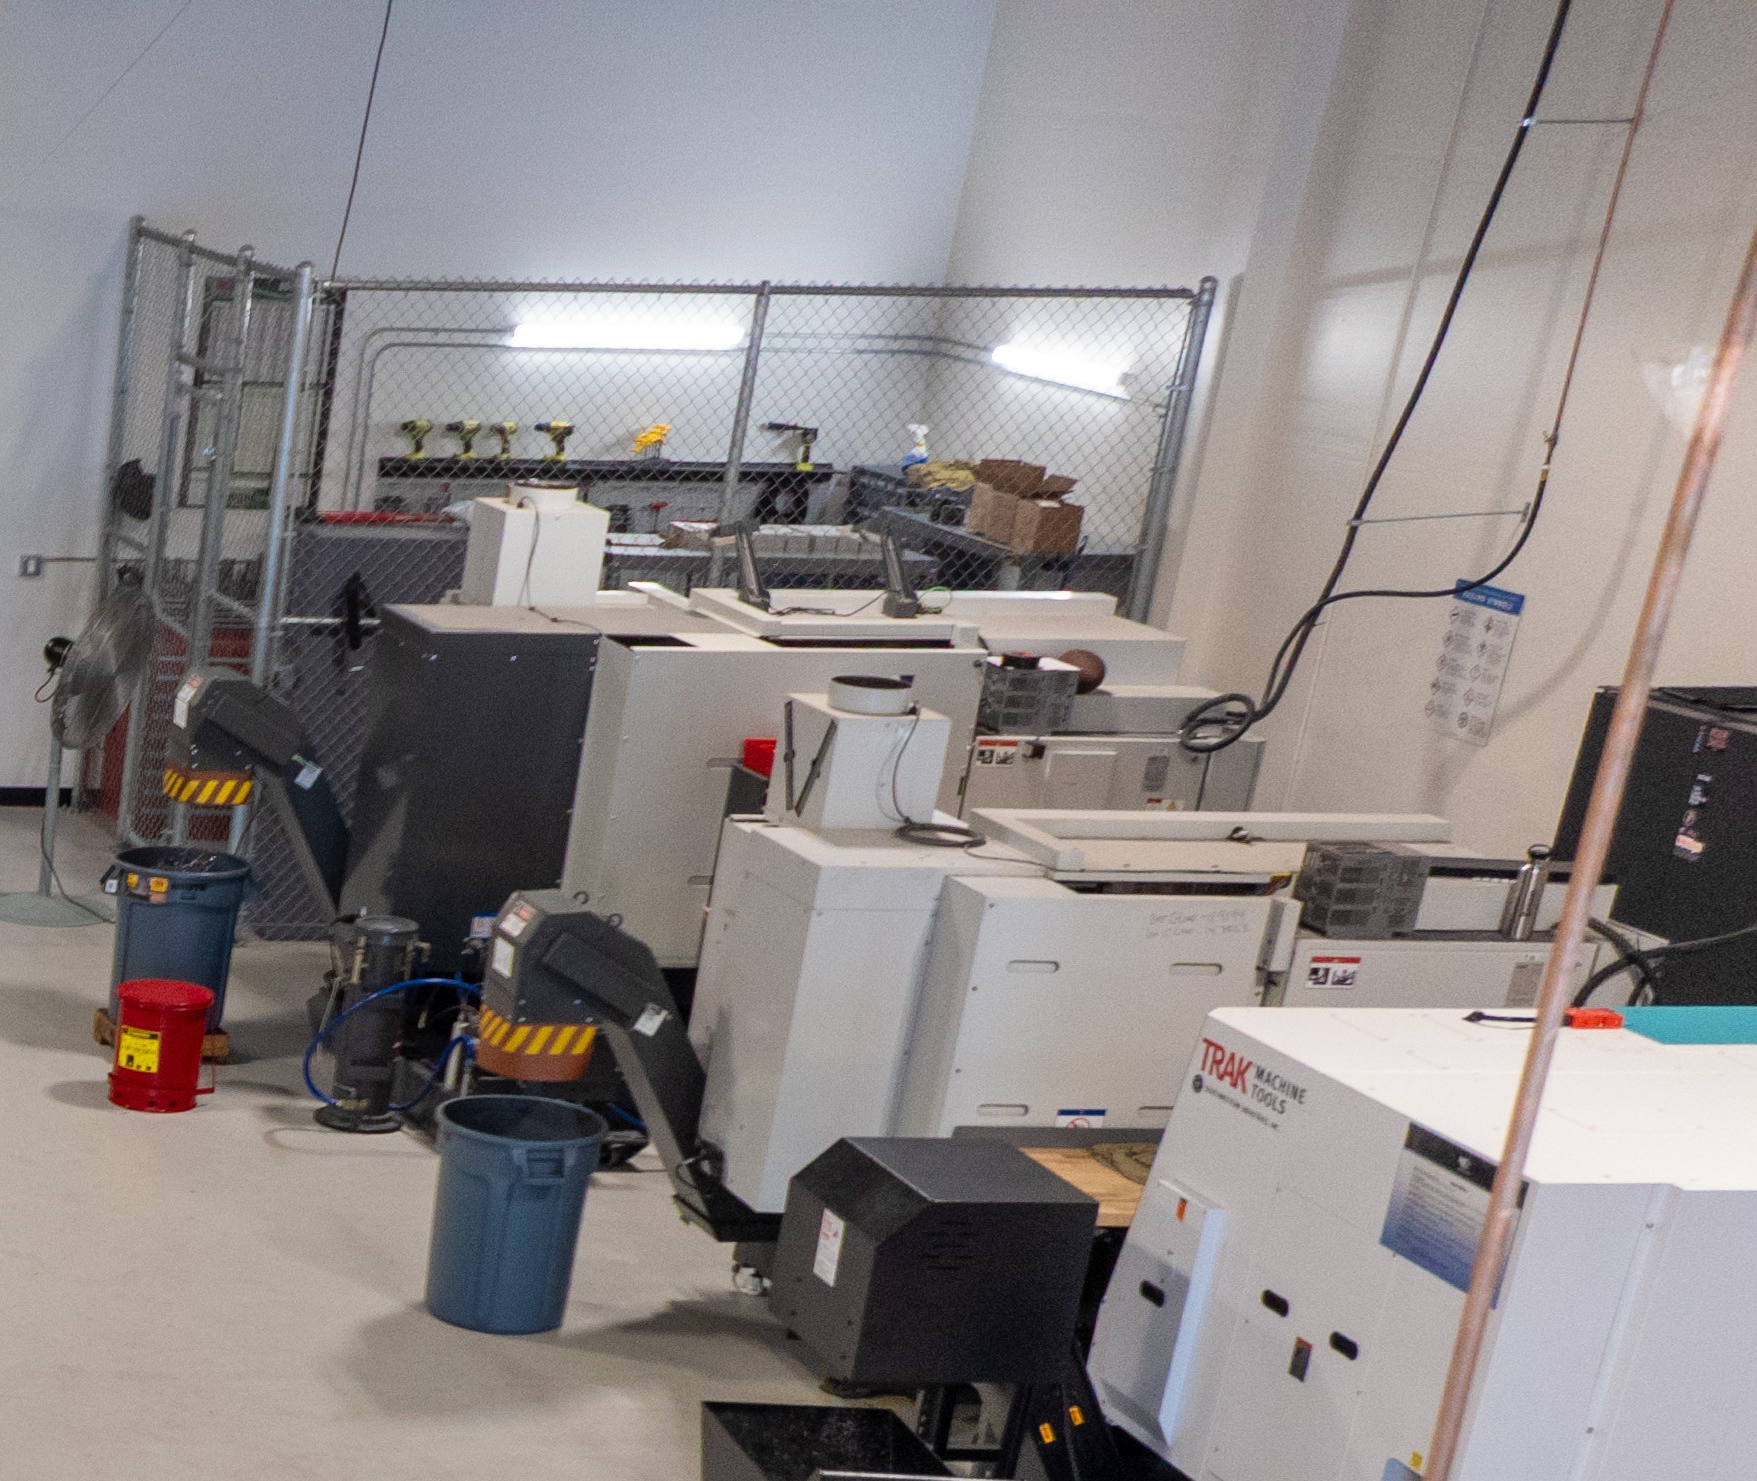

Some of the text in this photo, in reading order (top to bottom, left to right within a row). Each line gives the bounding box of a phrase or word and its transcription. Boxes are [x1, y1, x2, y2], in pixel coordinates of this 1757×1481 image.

[1201, 1036, 1307, 1105] TRAK MACHINE
[1251, 1083, 1287, 1115] TOOLS
